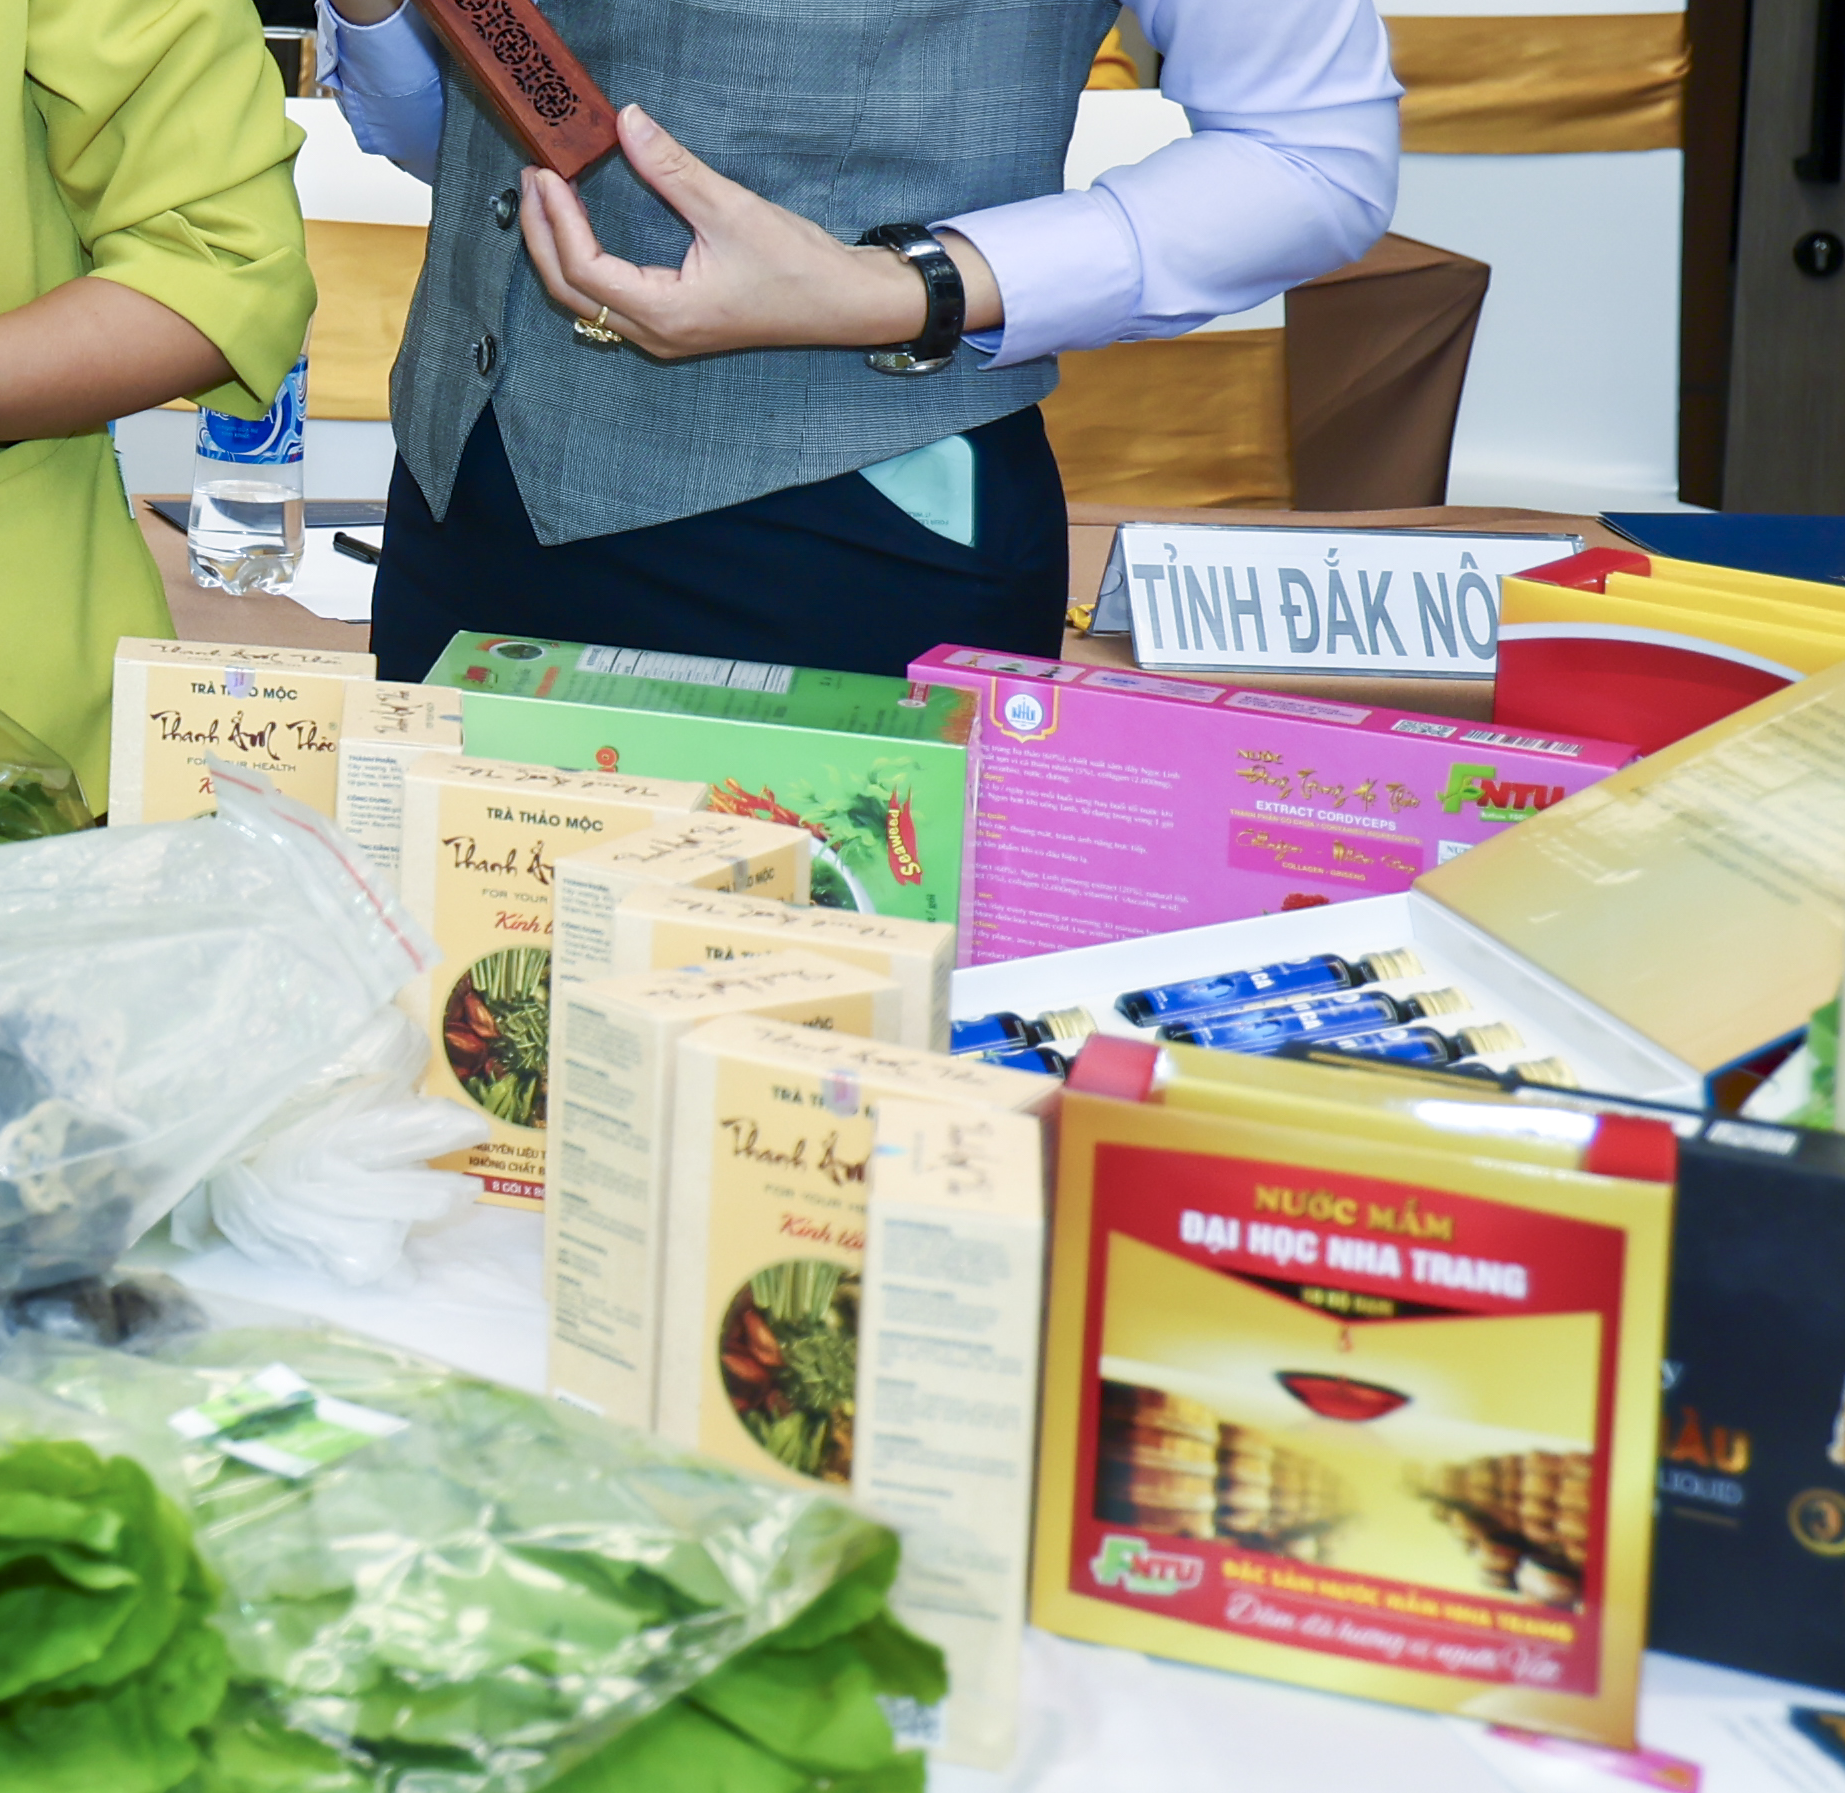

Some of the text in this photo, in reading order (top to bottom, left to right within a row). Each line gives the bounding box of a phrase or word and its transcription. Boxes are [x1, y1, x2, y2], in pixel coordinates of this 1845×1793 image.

[1132, 542, 1504, 662] TỈNH ĐẮK NÔ
[191, 682, 298, 702] TRÀ MỘC
[150, 710, 219, 744] Thanh
[286, 720, 337, 753] Thảo
[253, 763, 296, 772] HEALTH
[486, 807, 604, 834] TRÀ THẢO MỘC
[1256, 800, 1397, 832] EXTRACT CORDYCEPS
[442, 836, 518, 877] Thanh
[888, 808, 922, 877] Seaweed
[1282, 861, 1325, 875] COLLAGEN
[482, 888, 549, 904] FOR YOUR
[1091, 881, 1117, 892] extract
[495, 910, 541, 934] Kính
[1028, 909, 1060, 922] morning
[705, 945, 735, 960] TRÀ
[720, 1117, 807, 1171] Thanh
[1254, 1184, 1454, 1241] NƯỚC MẮM
[780, 1211, 833, 1244] Kính
[1179, 1209, 1529, 1300] ĐẠI HỌC NHA TRANG
